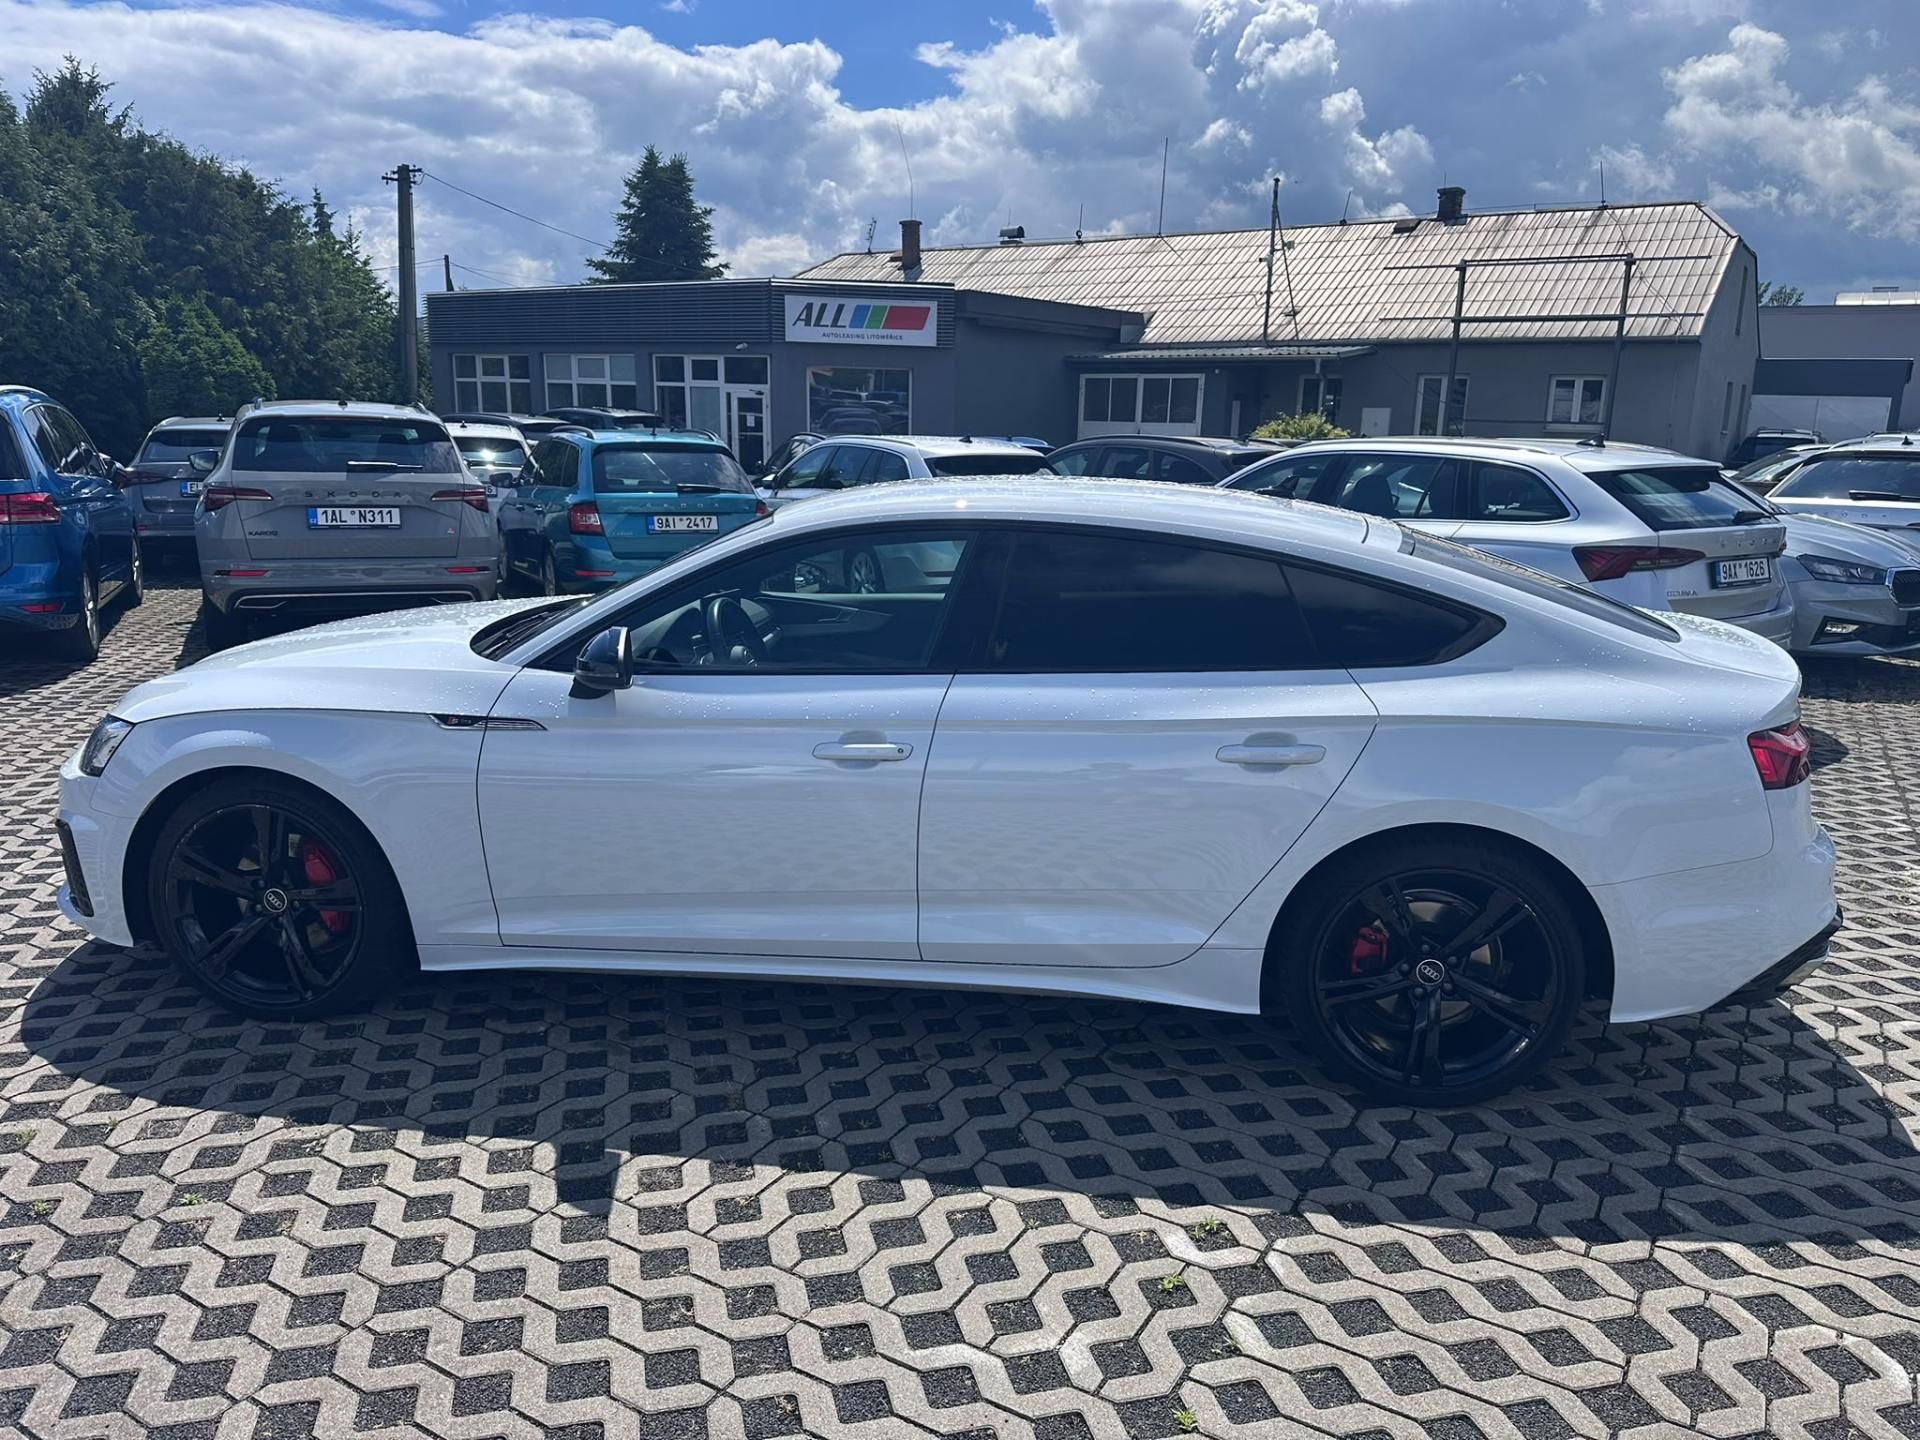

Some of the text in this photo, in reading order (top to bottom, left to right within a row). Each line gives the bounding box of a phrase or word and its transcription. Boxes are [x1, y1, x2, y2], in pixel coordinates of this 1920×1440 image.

[792, 302, 847, 328] ALL
[822, 332, 865, 340] AUTOLEASING
[321, 509, 393, 524] 1AL N311
[686, 517, 713, 529] 2417
[1722, 561, 1765, 580] 9AX 1626
